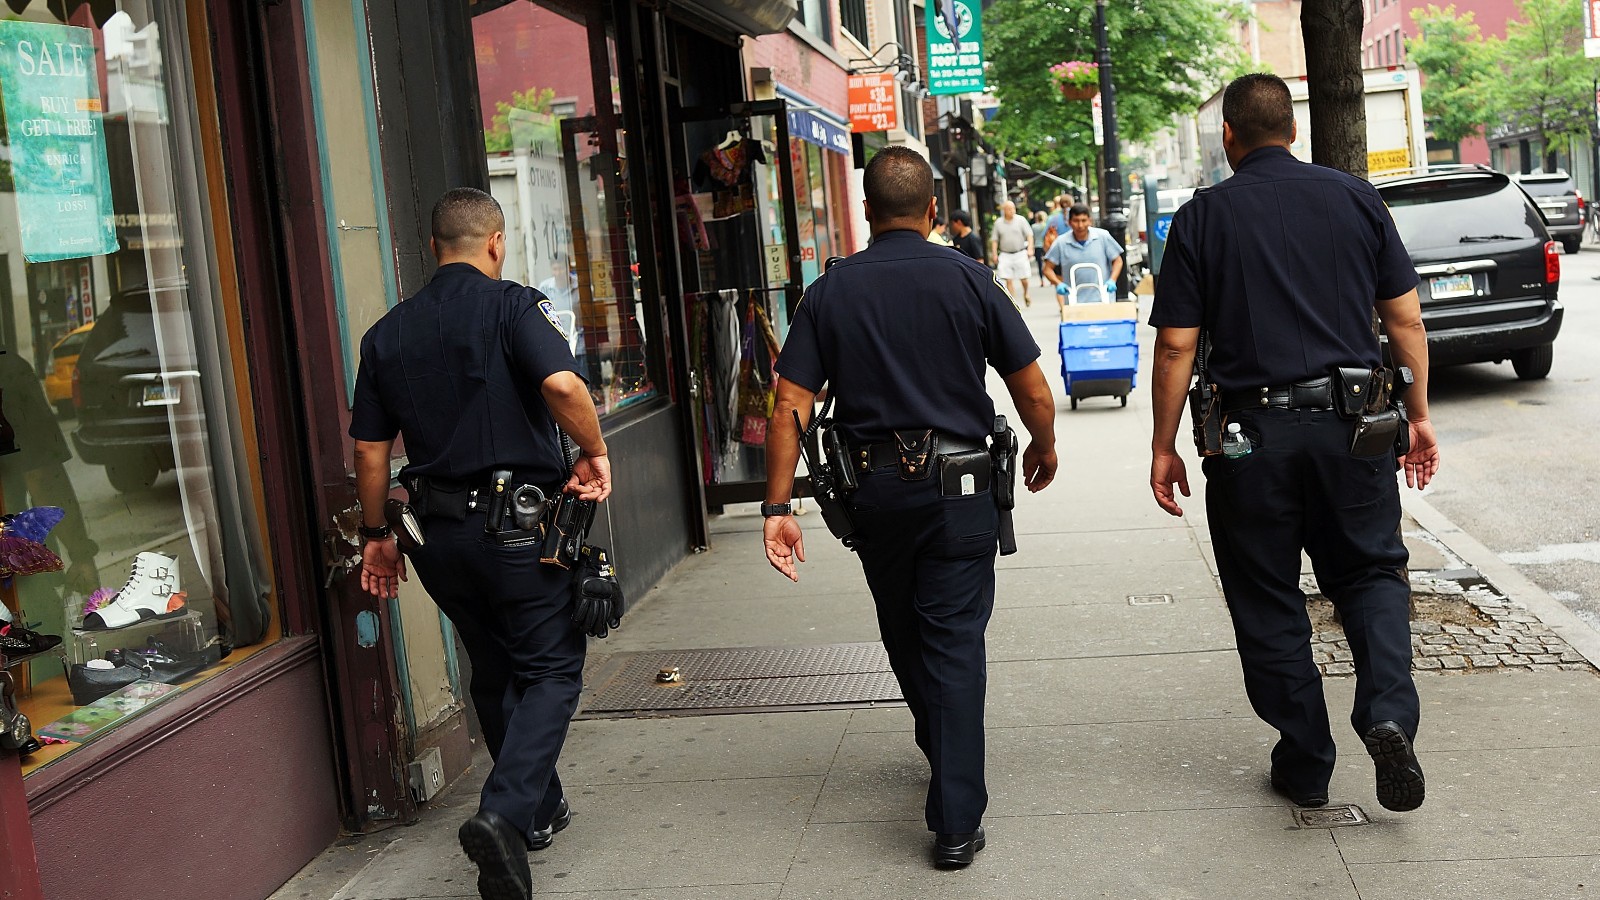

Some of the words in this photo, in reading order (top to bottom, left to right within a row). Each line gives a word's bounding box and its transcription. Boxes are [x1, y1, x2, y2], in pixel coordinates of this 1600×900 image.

[17, 40, 86, 77] SALE
[931, 55, 958, 67] FOOT
[40, 96, 69, 114] BUY
[21, 119, 51, 137] GET
[56, 119, 62, 136] 1
[67, 119, 97, 136] FREE!
[530, 139, 544, 159] ANY
[46, 154, 87, 166] ENRICA
[57, 201, 88, 212] LOSSI
[770, 247, 781, 280] PUSH
[747, 419, 765, 435] NY
